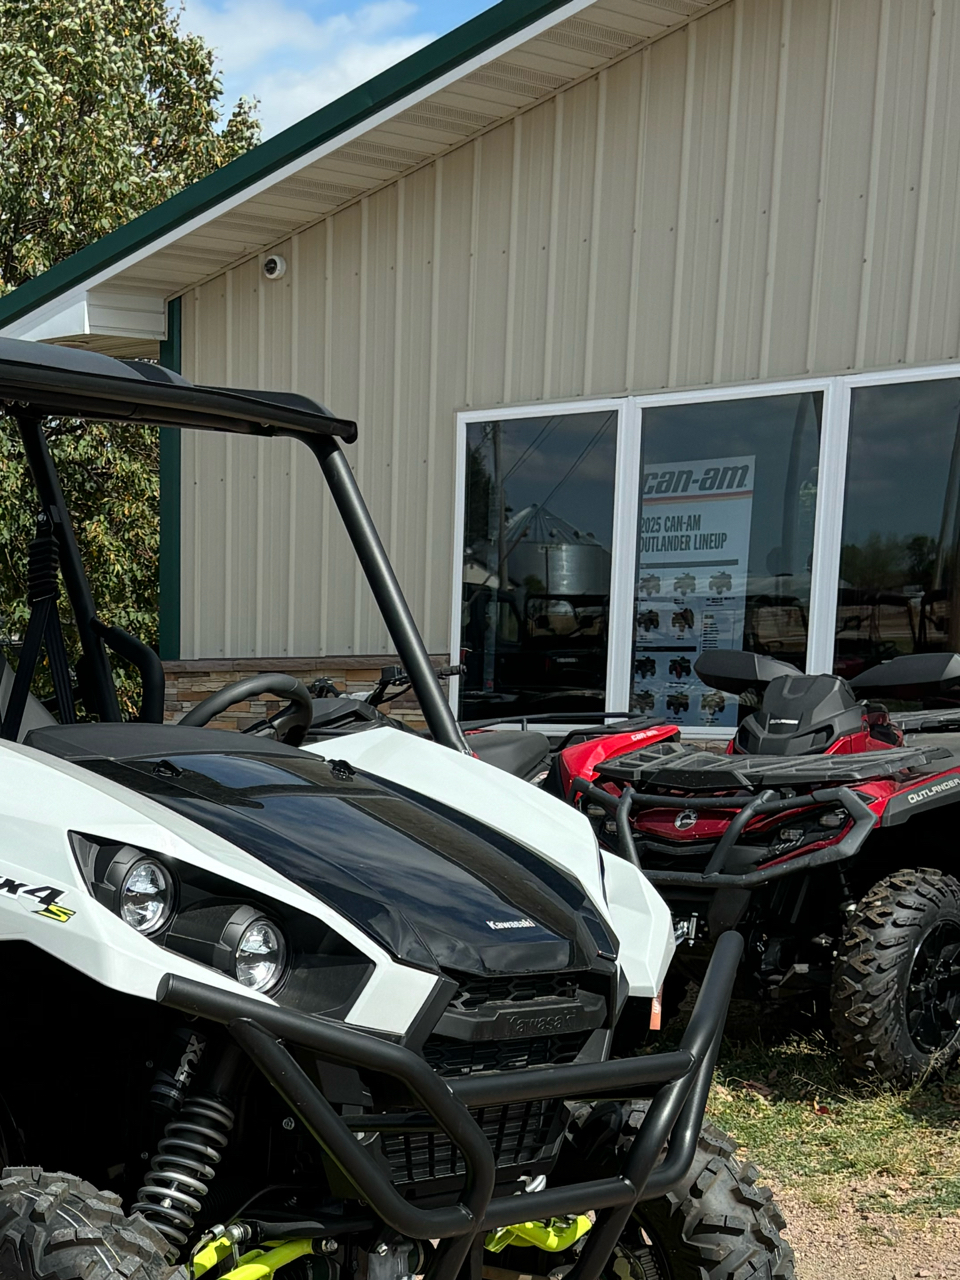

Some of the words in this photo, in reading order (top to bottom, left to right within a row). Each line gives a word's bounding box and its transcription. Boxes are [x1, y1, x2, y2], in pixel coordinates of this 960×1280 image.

[643, 465, 749, 494] can-am
[641, 517, 661, 533] 2025
[664, 515, 701, 532] CAN-AM
[694, 532, 727, 551] LINEUP
[907, 778, 960, 803] OUTLANDER
[485, 918, 536, 930] Kawasaki
